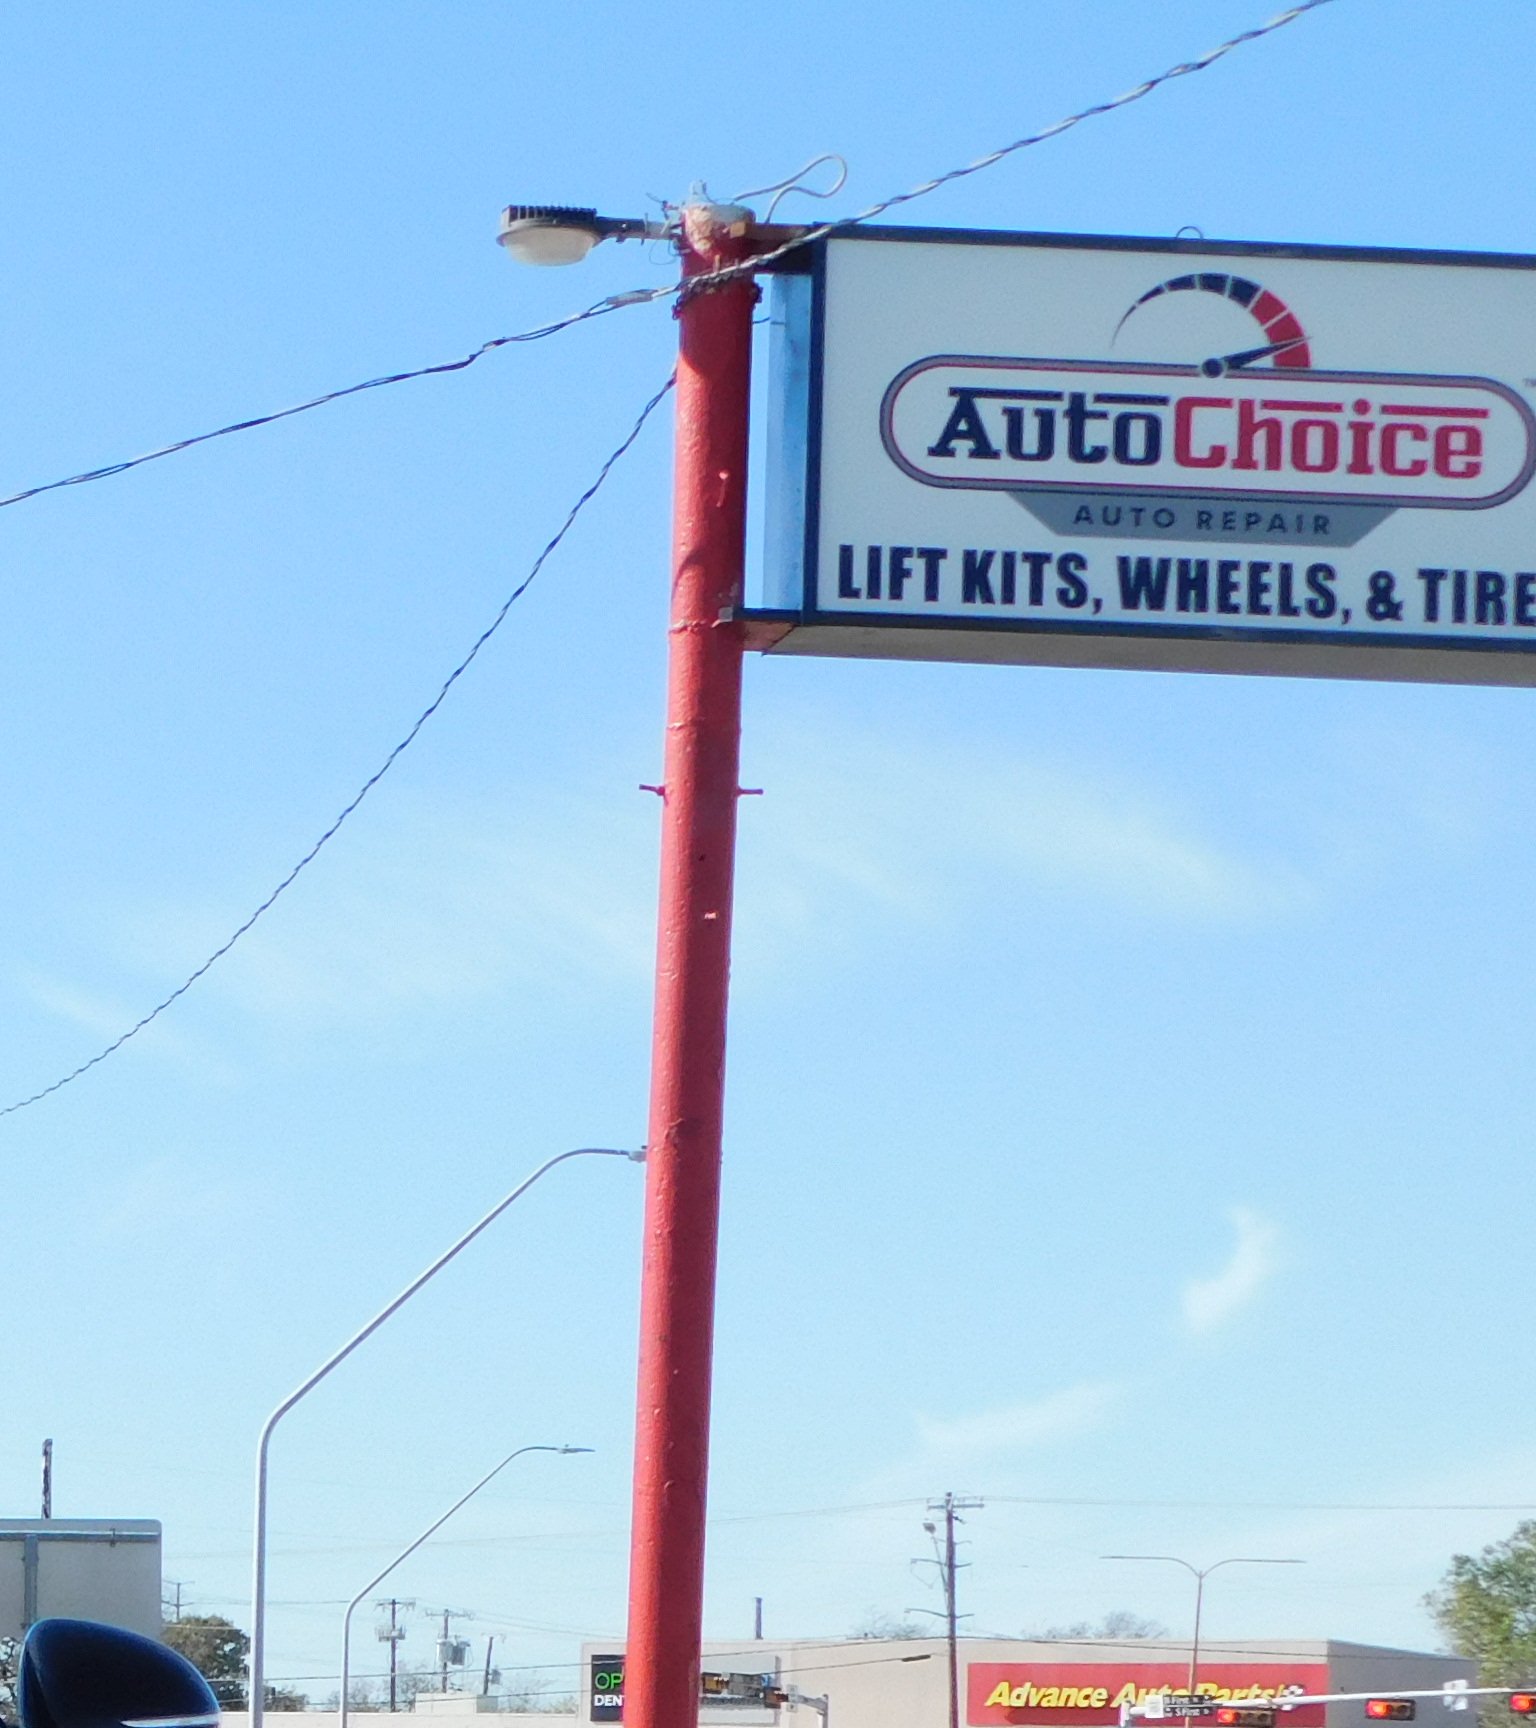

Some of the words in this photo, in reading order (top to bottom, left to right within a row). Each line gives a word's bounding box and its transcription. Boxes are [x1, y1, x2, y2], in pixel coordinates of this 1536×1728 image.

[927, 386, 1490, 479] AutoChoice
[1073, 504, 1176, 529] AUTO
[1195, 509, 1331, 535] REPAIR
[838, 544, 948, 602] LIFT
[961, 549, 1103, 614] KITS,
[1116, 555, 1352, 625] WHEELS,
[1366, 569, 1404, 621] &
[1417, 568, 1536, 626] TIRE
[595, 1672, 625, 1690] OP
[984, 1681, 1108, 1708] Advance
